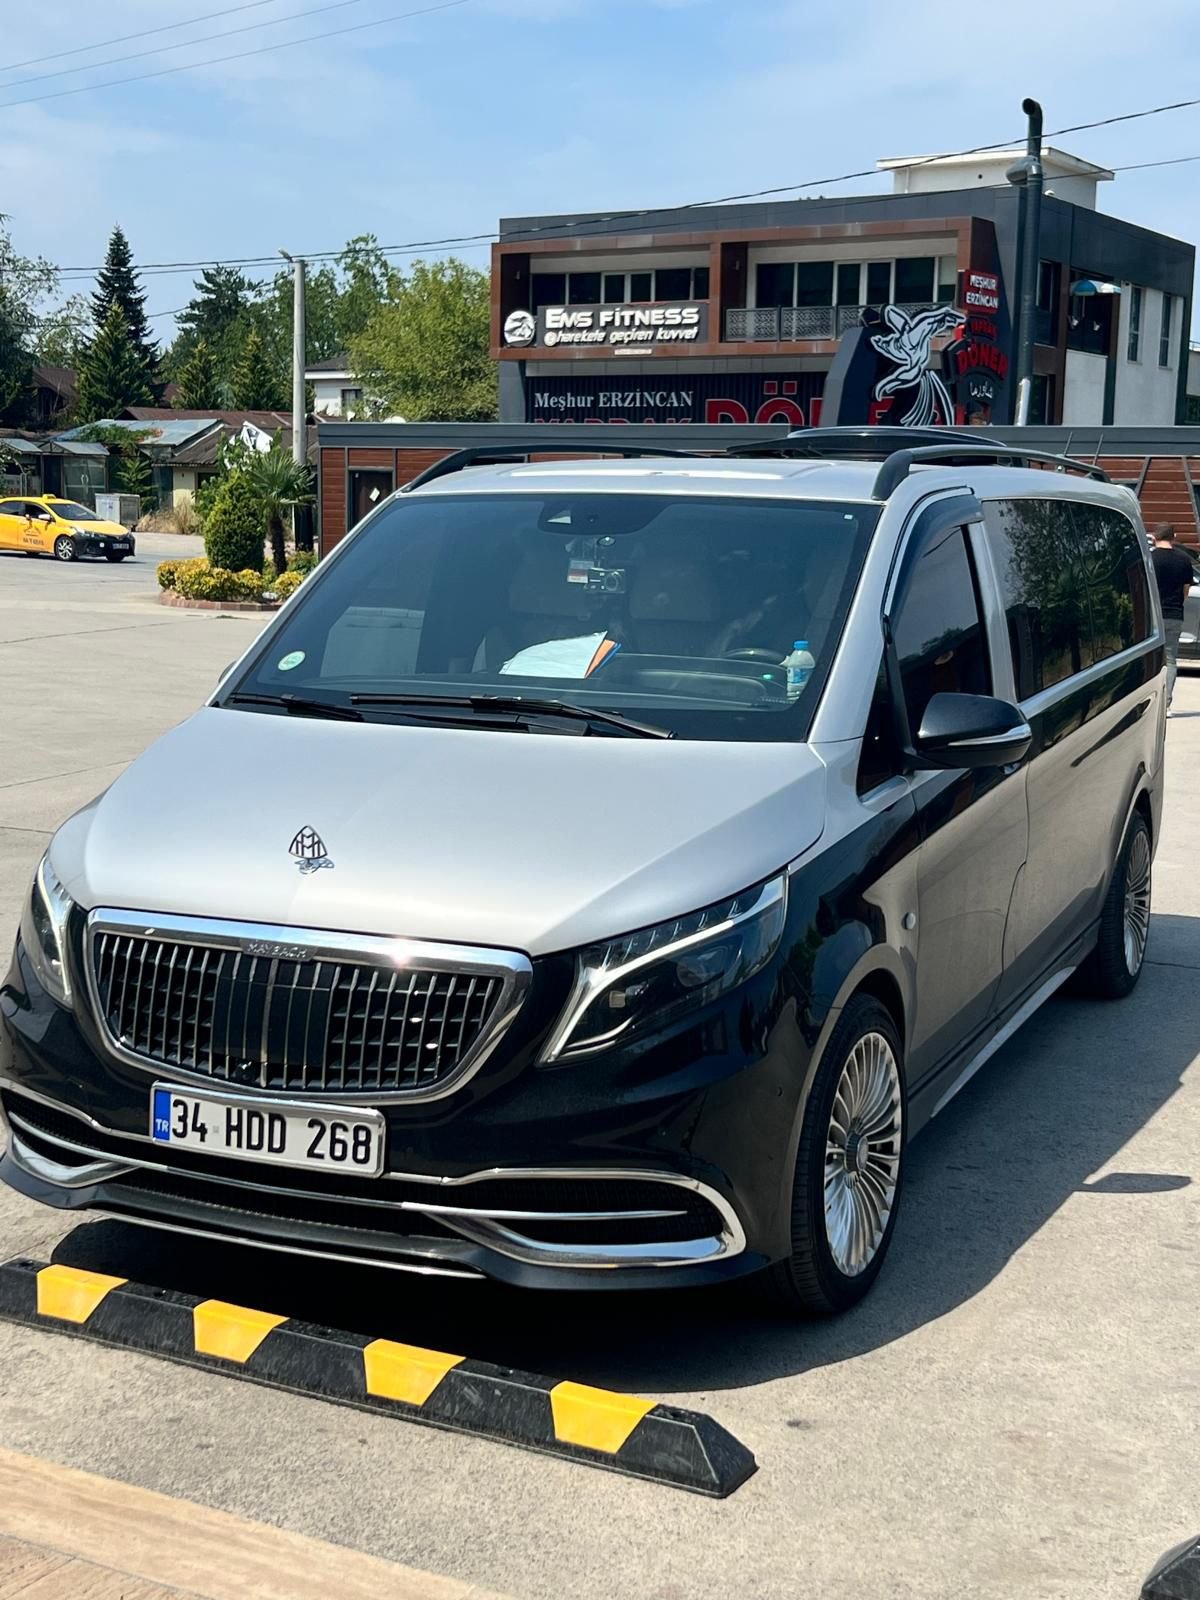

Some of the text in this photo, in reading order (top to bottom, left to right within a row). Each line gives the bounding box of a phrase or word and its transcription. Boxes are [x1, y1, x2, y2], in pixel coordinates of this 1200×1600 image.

[599, 307, 700, 327] FİTNESS
[557, 326, 699, 345] harekete geçiren kuvvet
[534, 388, 694, 412] Meşhur ERZİNCAN
[155, 1098, 373, 1165] TR 34 HDD 268
